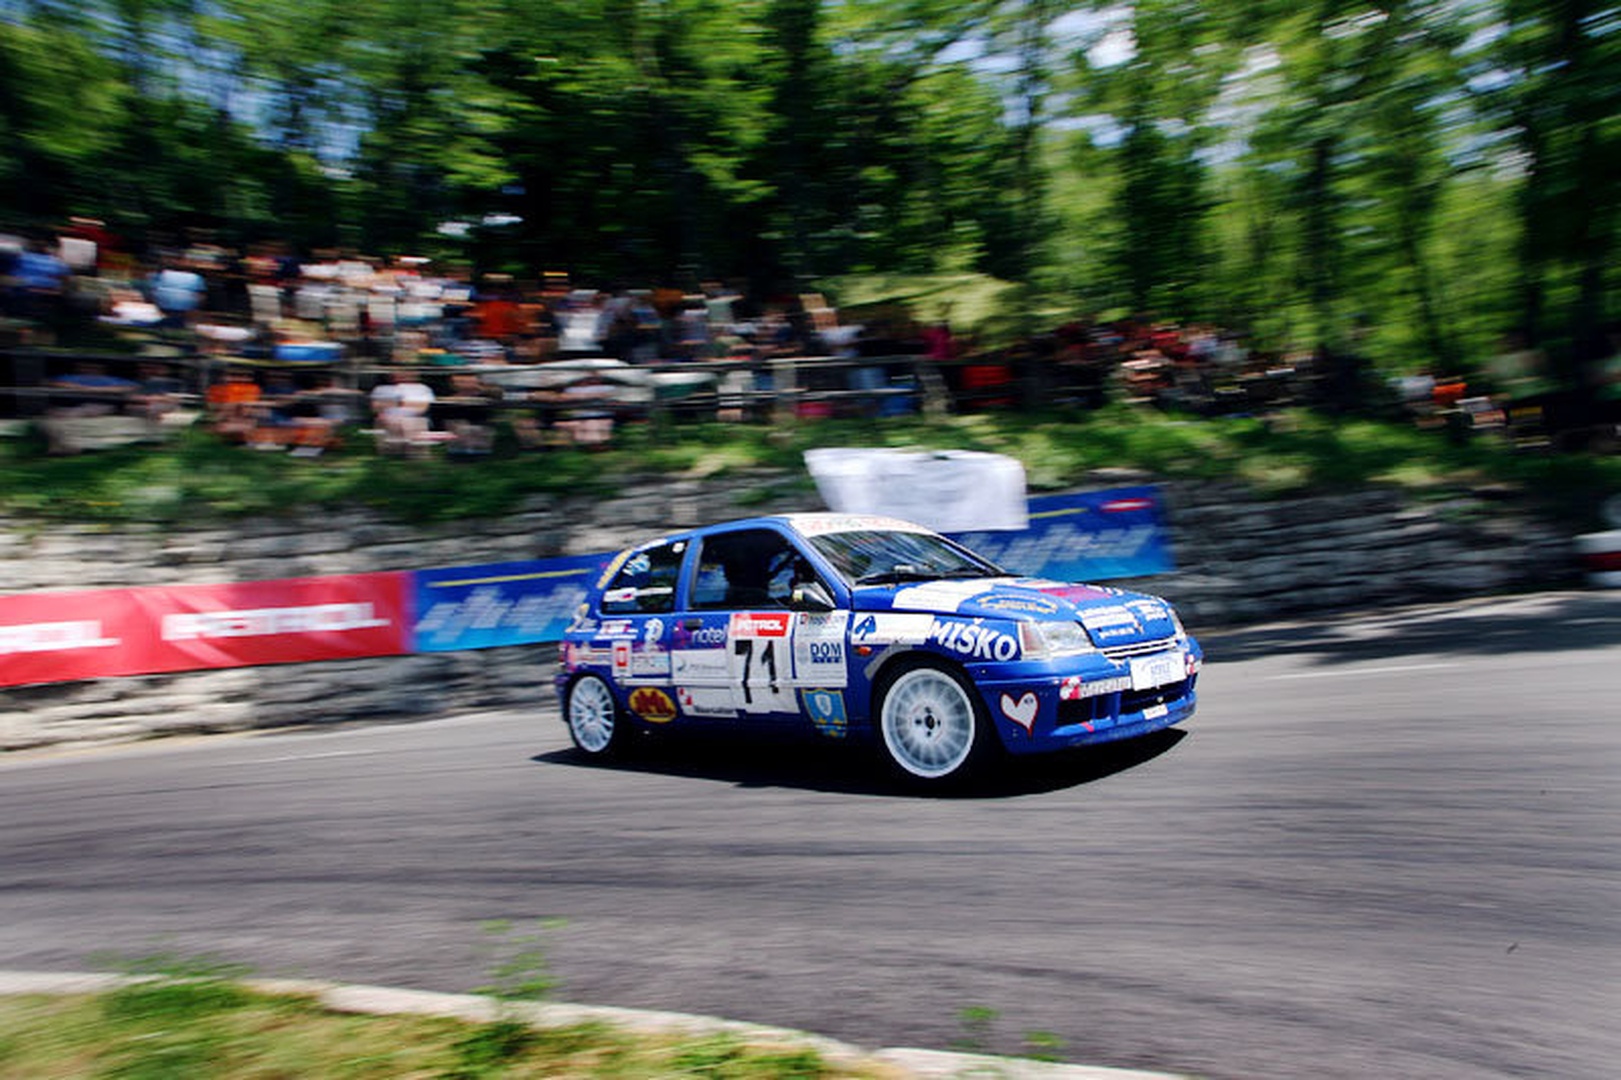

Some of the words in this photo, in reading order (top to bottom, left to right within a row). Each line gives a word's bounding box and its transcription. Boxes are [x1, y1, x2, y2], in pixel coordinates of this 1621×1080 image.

[810, 642, 842, 657] DOM
[927, 617, 1017, 661] MIŠKO
[734, 639, 780, 704] 71
